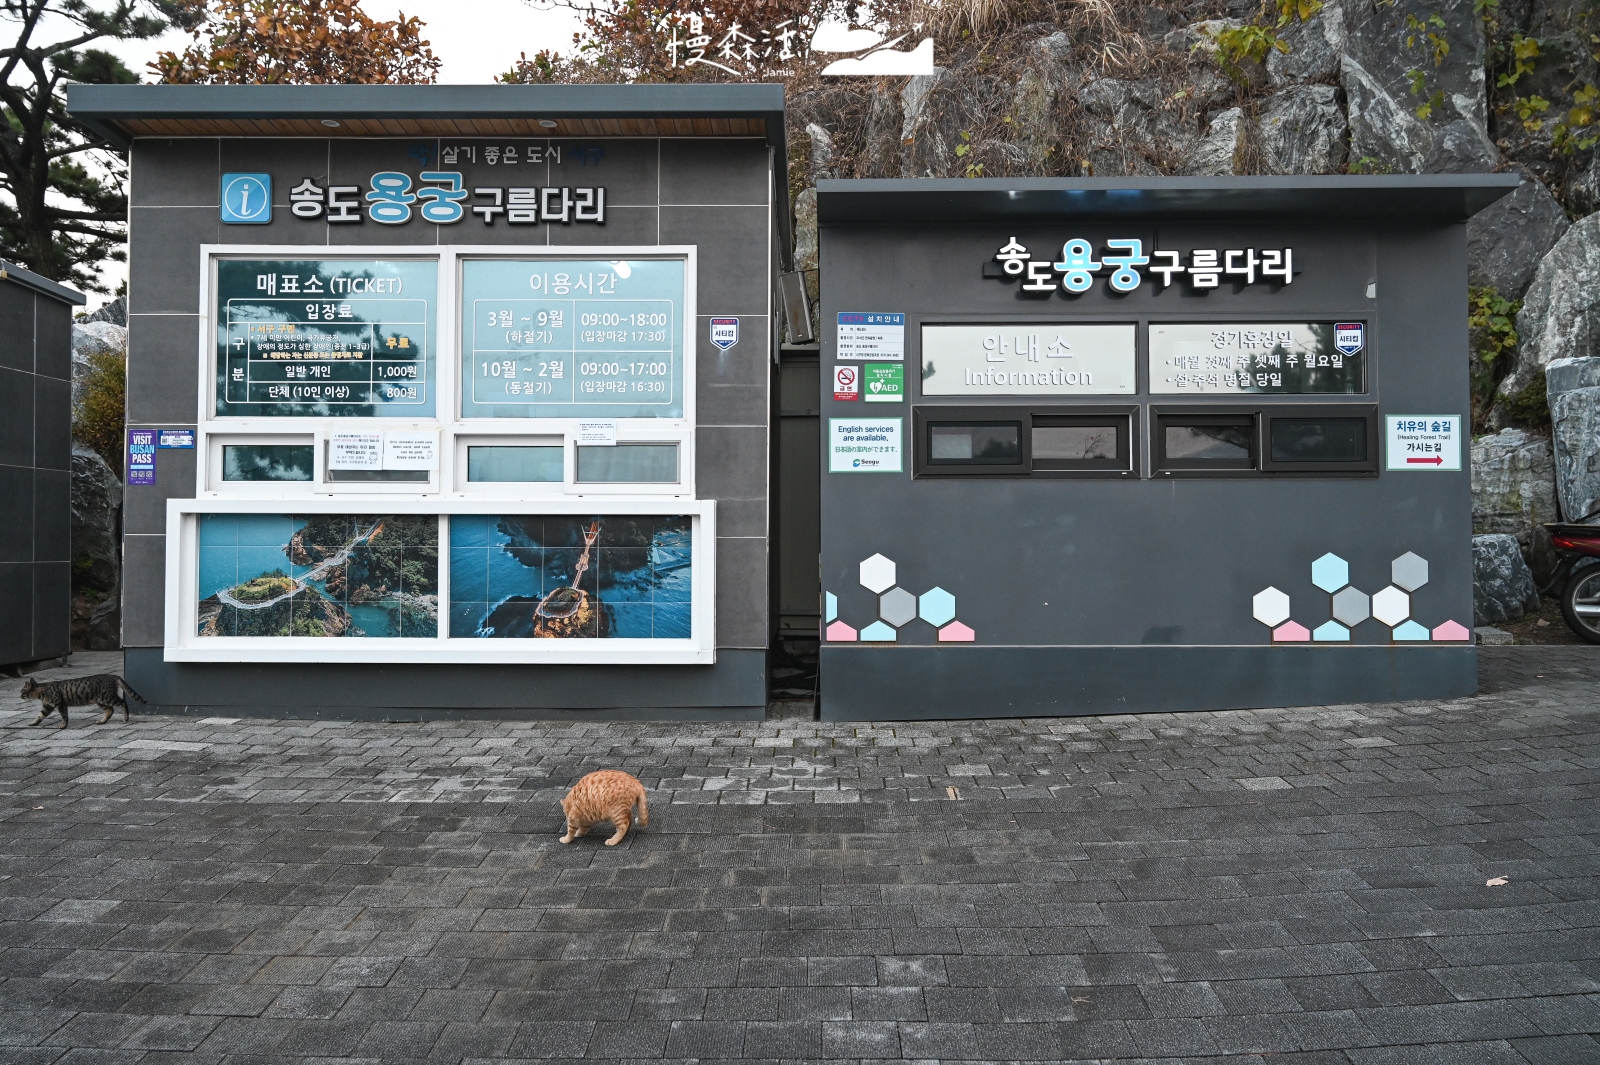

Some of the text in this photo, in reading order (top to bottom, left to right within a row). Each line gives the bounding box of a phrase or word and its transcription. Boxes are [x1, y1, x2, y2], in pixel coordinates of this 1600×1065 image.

[442, 146, 476, 164] 살기
[484, 146, 519, 165] 좋은
[527, 146, 561, 164] 도시
[257, 273, 403, 295] 매표소 (TICKET)
[530, 272, 618, 295] 이용시간
[305, 303, 354, 321] 입장료
[488, 310, 514, 328] 3월
[537, 310, 564, 328] 9월
[581, 313, 667, 326] 09:00~18:00
[385, 337, 410, 349] 무료
[505, 331, 553, 344] (하절기)
[581, 331, 666, 343] (입장마감 17:30)
[1210, 331, 1293, 350] 정기휴장일
[982, 334, 1073, 362] 안내소
[231, 337, 246, 381] 구 분
[1174, 354, 1344, 370] 매월 첫째 주 셋째 주 월요일
[285, 366, 331, 378] 일반 개인
[377, 366, 417, 378] 1,000원
[481, 361, 517, 378] 10월
[538, 361, 564, 378] 2월
[580, 362, 667, 375] 09:00~17:00
[964, 367, 1093, 386] Information
[1224, 373, 1251, 388] 명절
[1256, 372, 1282, 388] 당일
[269, 386, 350, 398] 단체 (10인 이상)
[386, 387, 417, 399] 800원
[505, 382, 552, 395] (동절기)
[580, 381, 666, 393] (입장마감 16:30)
[838, 425, 894, 434] English services
[1396, 420, 1451, 432] 치유의 숲길
[133, 435, 152, 445] VISIT
[856, 434, 889, 442] available.
[130, 444, 155, 454] BUSAN
[1407, 442, 1442, 452] 가시는길
[132, 454, 152, 464] PASS
